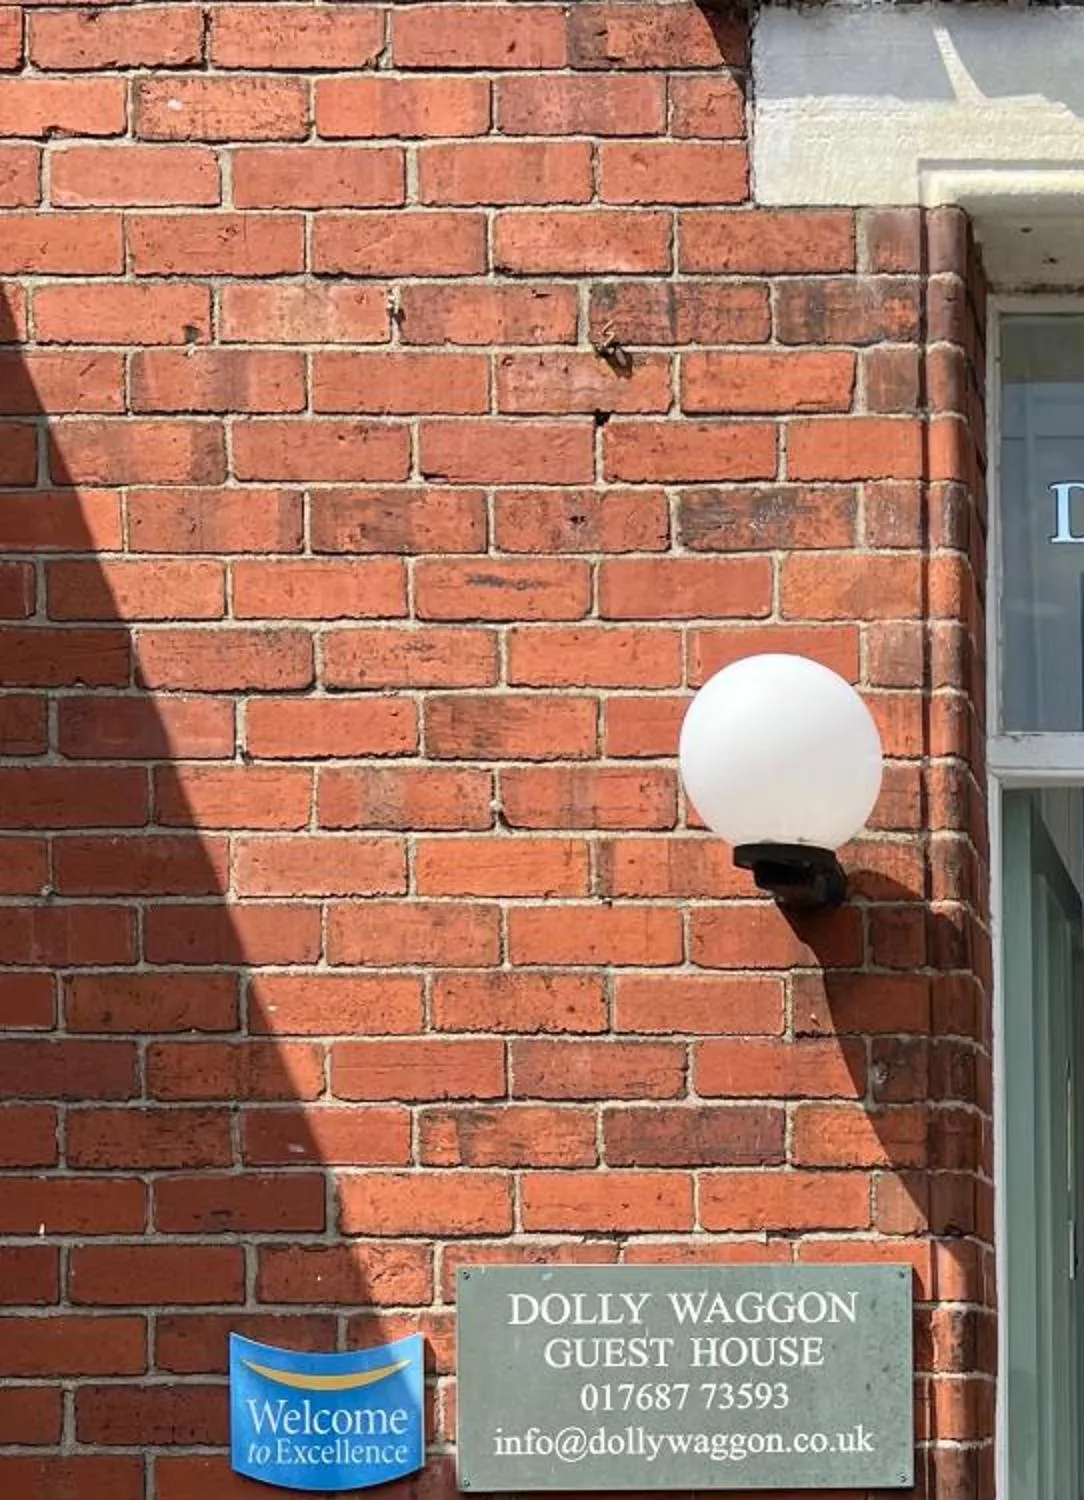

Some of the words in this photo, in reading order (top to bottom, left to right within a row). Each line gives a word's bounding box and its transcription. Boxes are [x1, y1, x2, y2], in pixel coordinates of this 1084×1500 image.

[508, 1293, 651, 1326] DOLLY
[667, 1290, 860, 1325] WAGGON
[543, 1336, 674, 1369] GUEST
[690, 1335, 825, 1367] HOUSE
[580, 1383, 690, 1412] 017687
[699, 1382, 790, 1410] 73593
[248, 1399, 409, 1435] Welcome
[247, 1440, 272, 1465] to
[276, 1439, 409, 1465] Excellence
[494, 1425, 874, 1462] info@dollywaggon.co.uk
